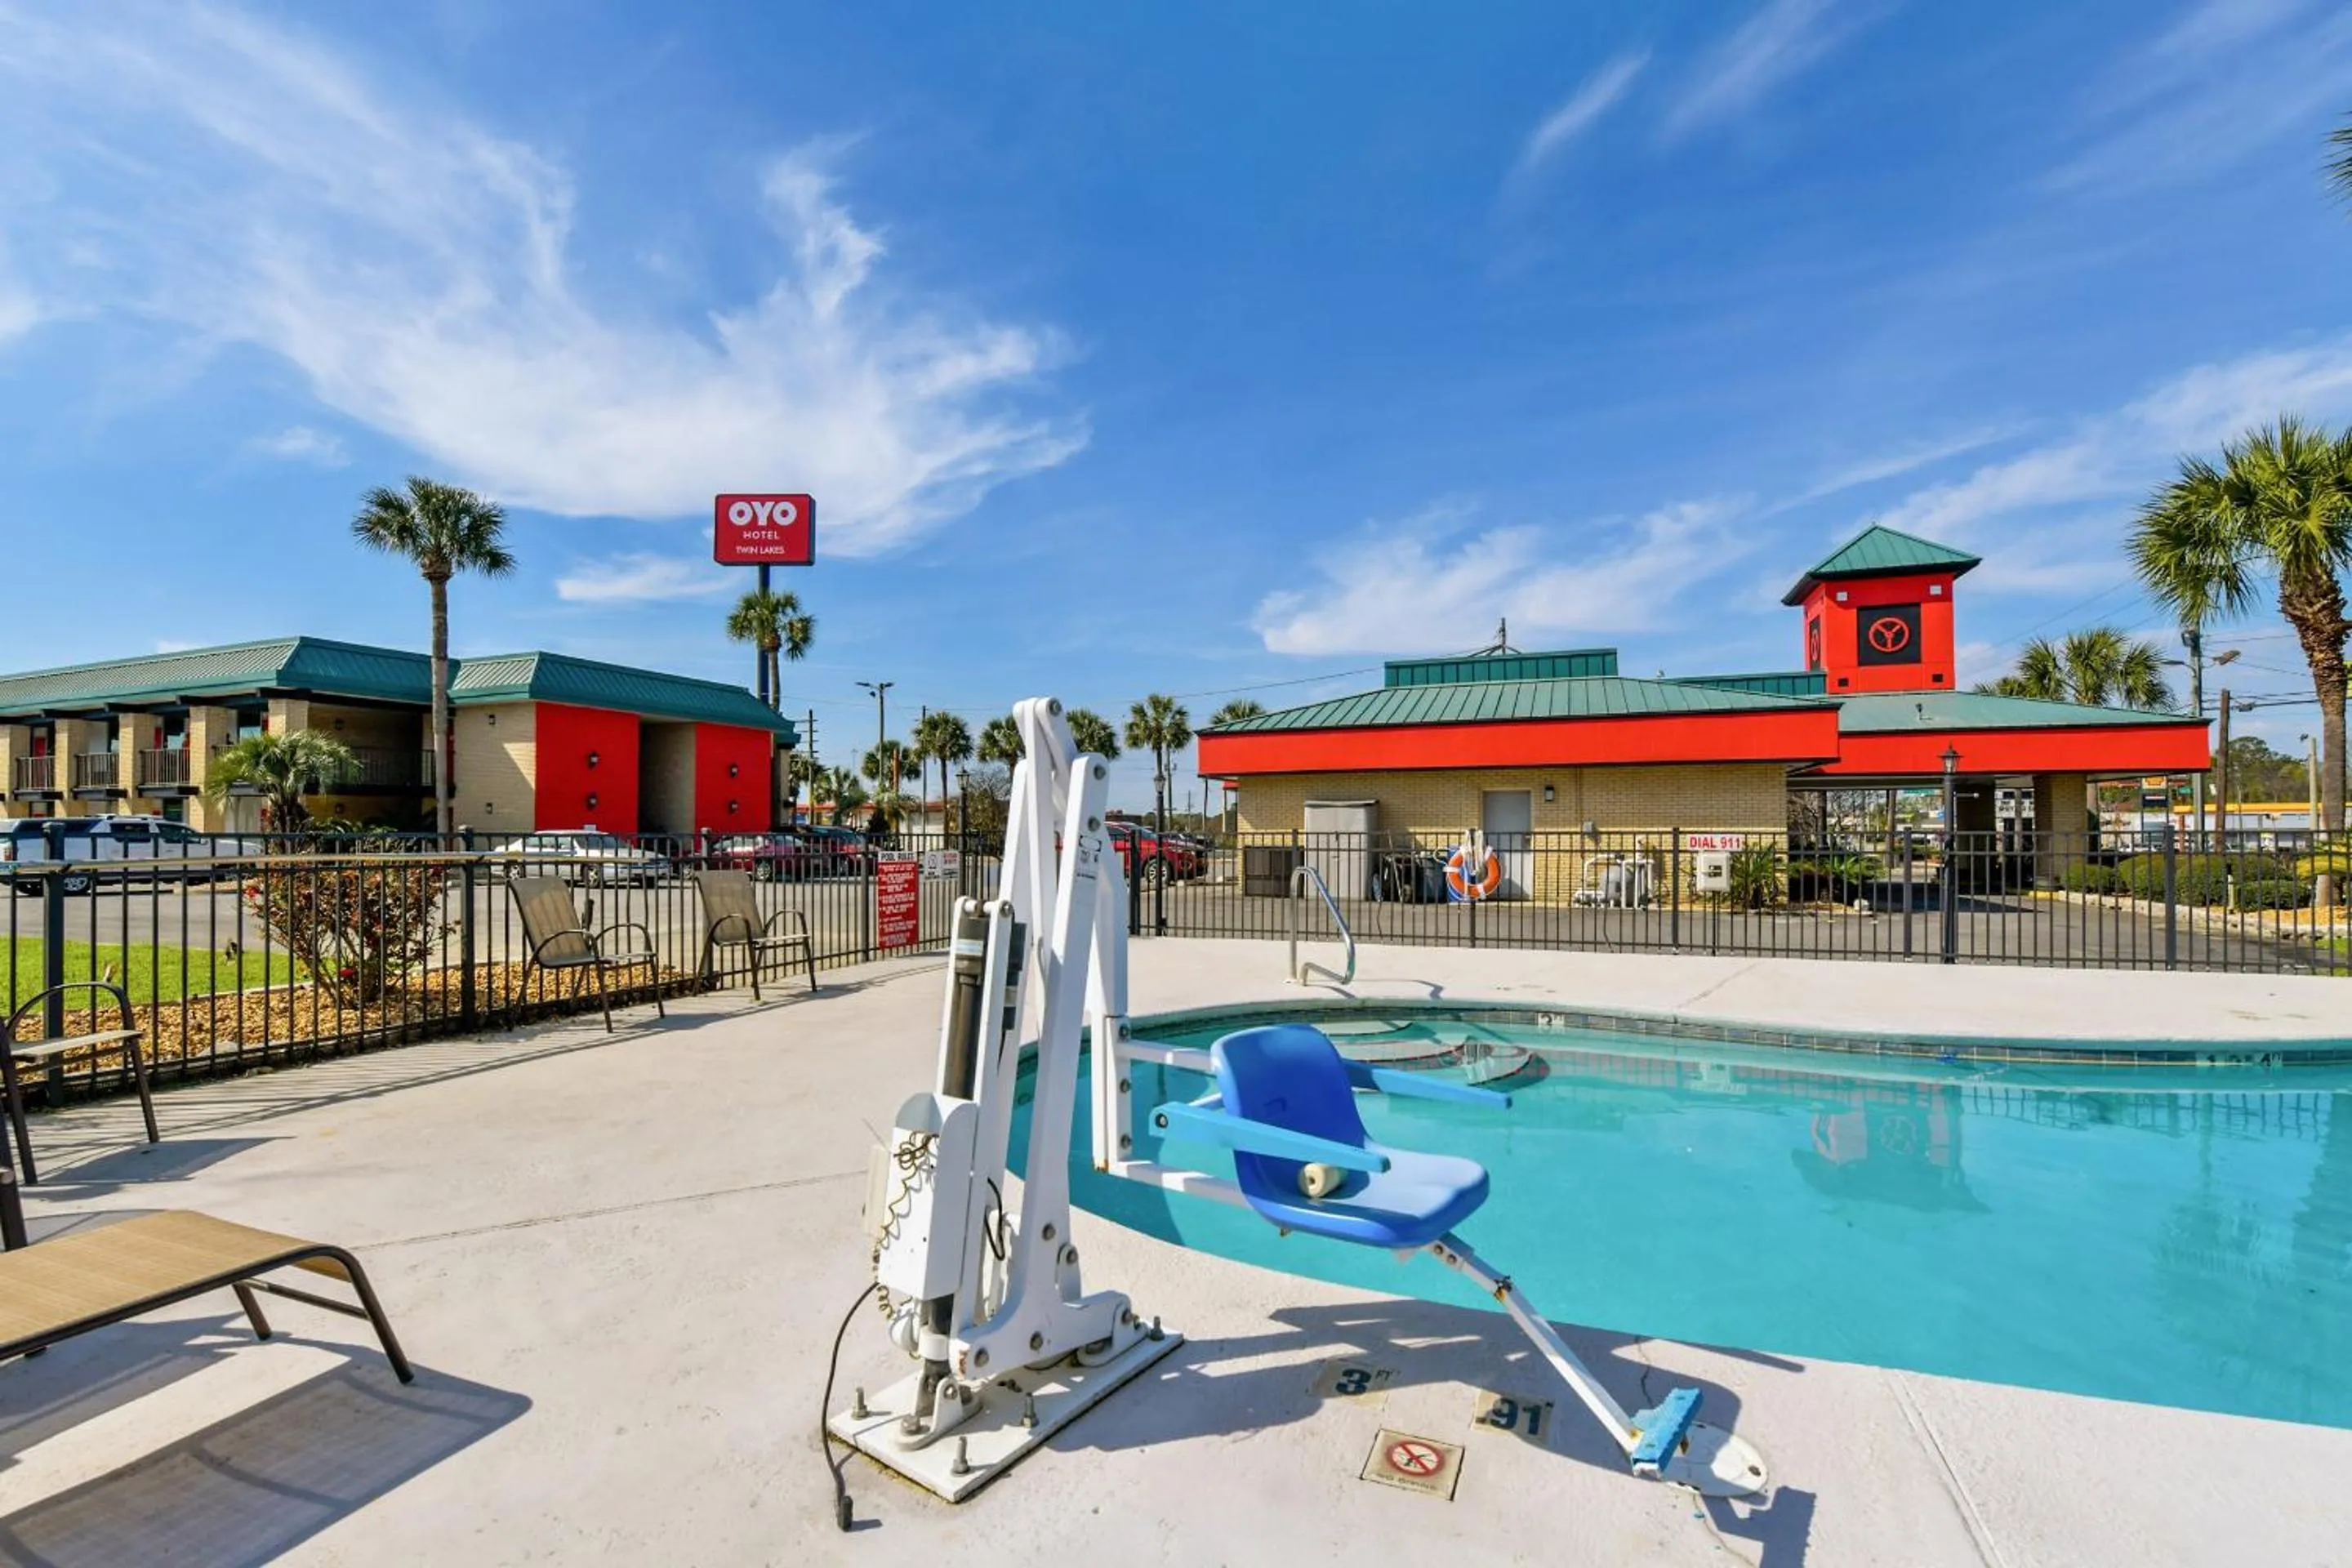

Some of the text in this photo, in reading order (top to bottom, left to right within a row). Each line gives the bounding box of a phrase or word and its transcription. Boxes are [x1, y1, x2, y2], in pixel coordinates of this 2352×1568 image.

[728, 501, 797, 526] OYO
[742, 530, 780, 540] HOTEL
[736, 545, 785, 555] TWIN LAKES
[1690, 836, 1740, 849] DIAL 911
[881, 852, 896, 862] POOL
[1335, 1369, 1371, 1396] 3
